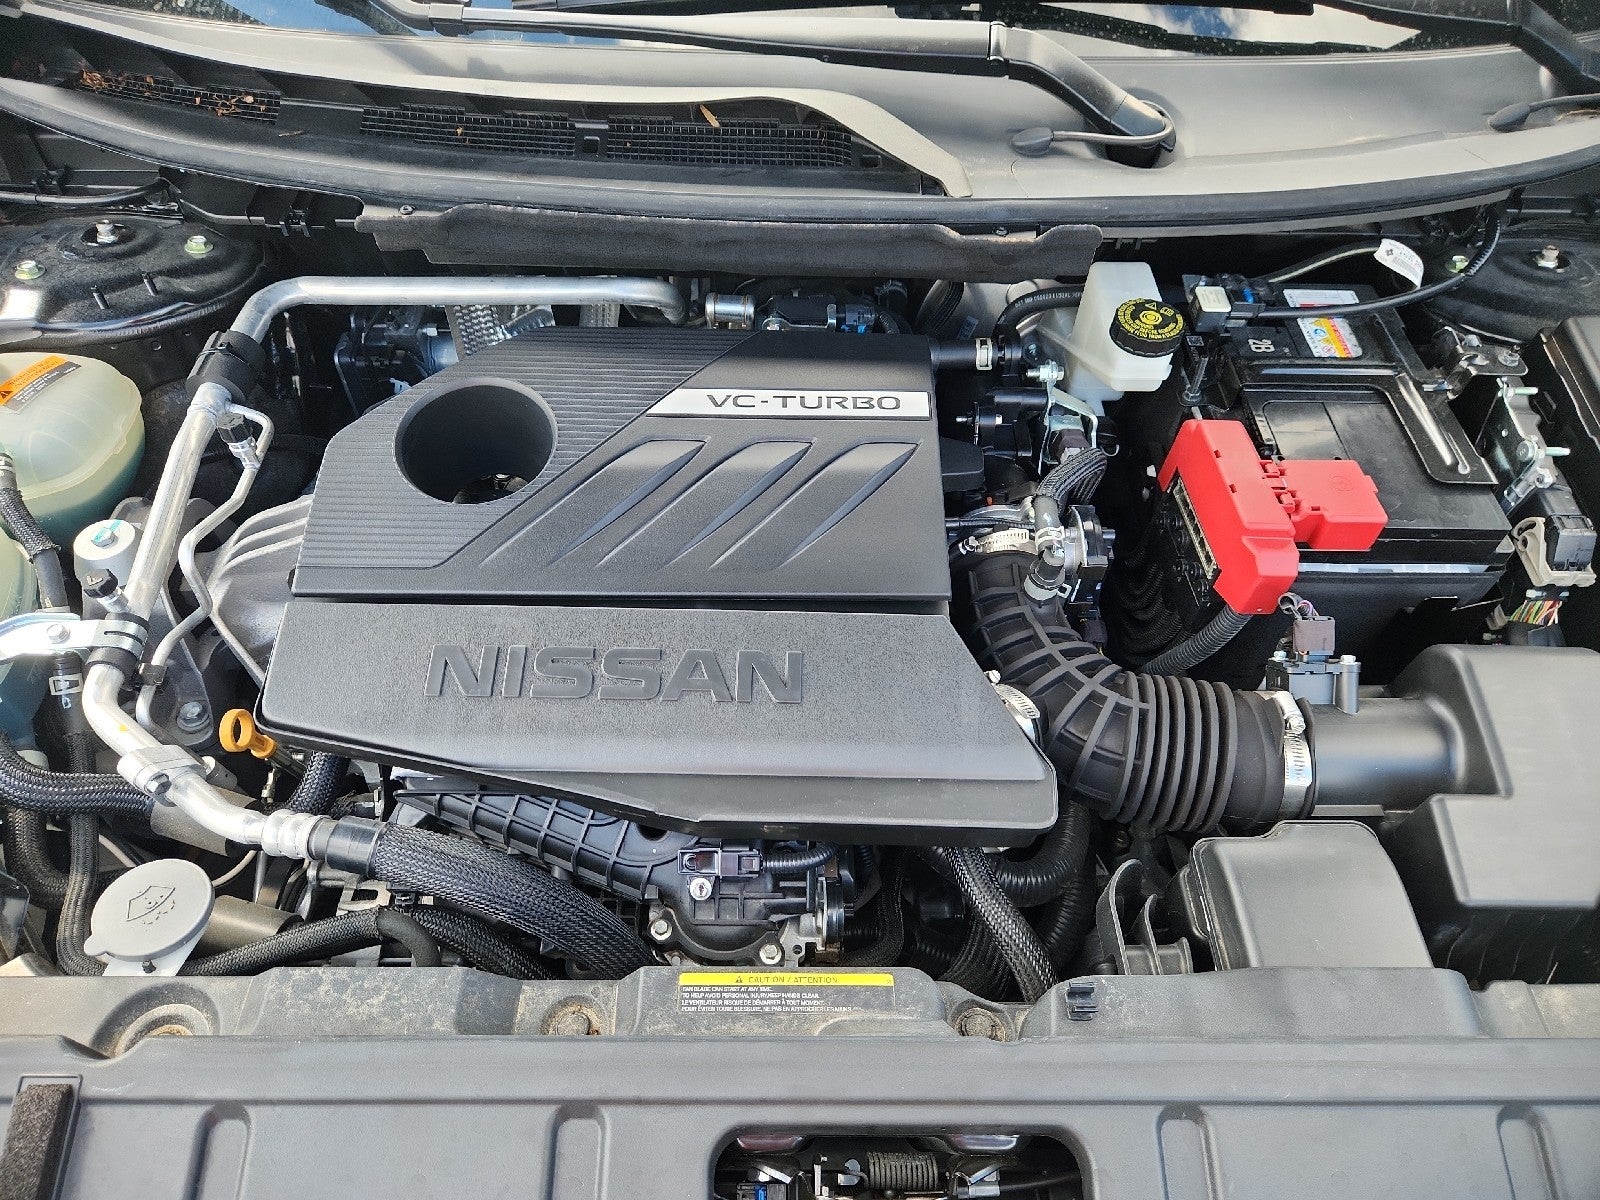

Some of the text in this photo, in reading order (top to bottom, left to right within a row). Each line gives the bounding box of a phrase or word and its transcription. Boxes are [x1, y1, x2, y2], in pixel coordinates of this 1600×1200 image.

[706, 394, 901, 410] VC-TURBO
[423, 643, 803, 704] NISSAN
[793, 976, 838, 984] ATTENTION
